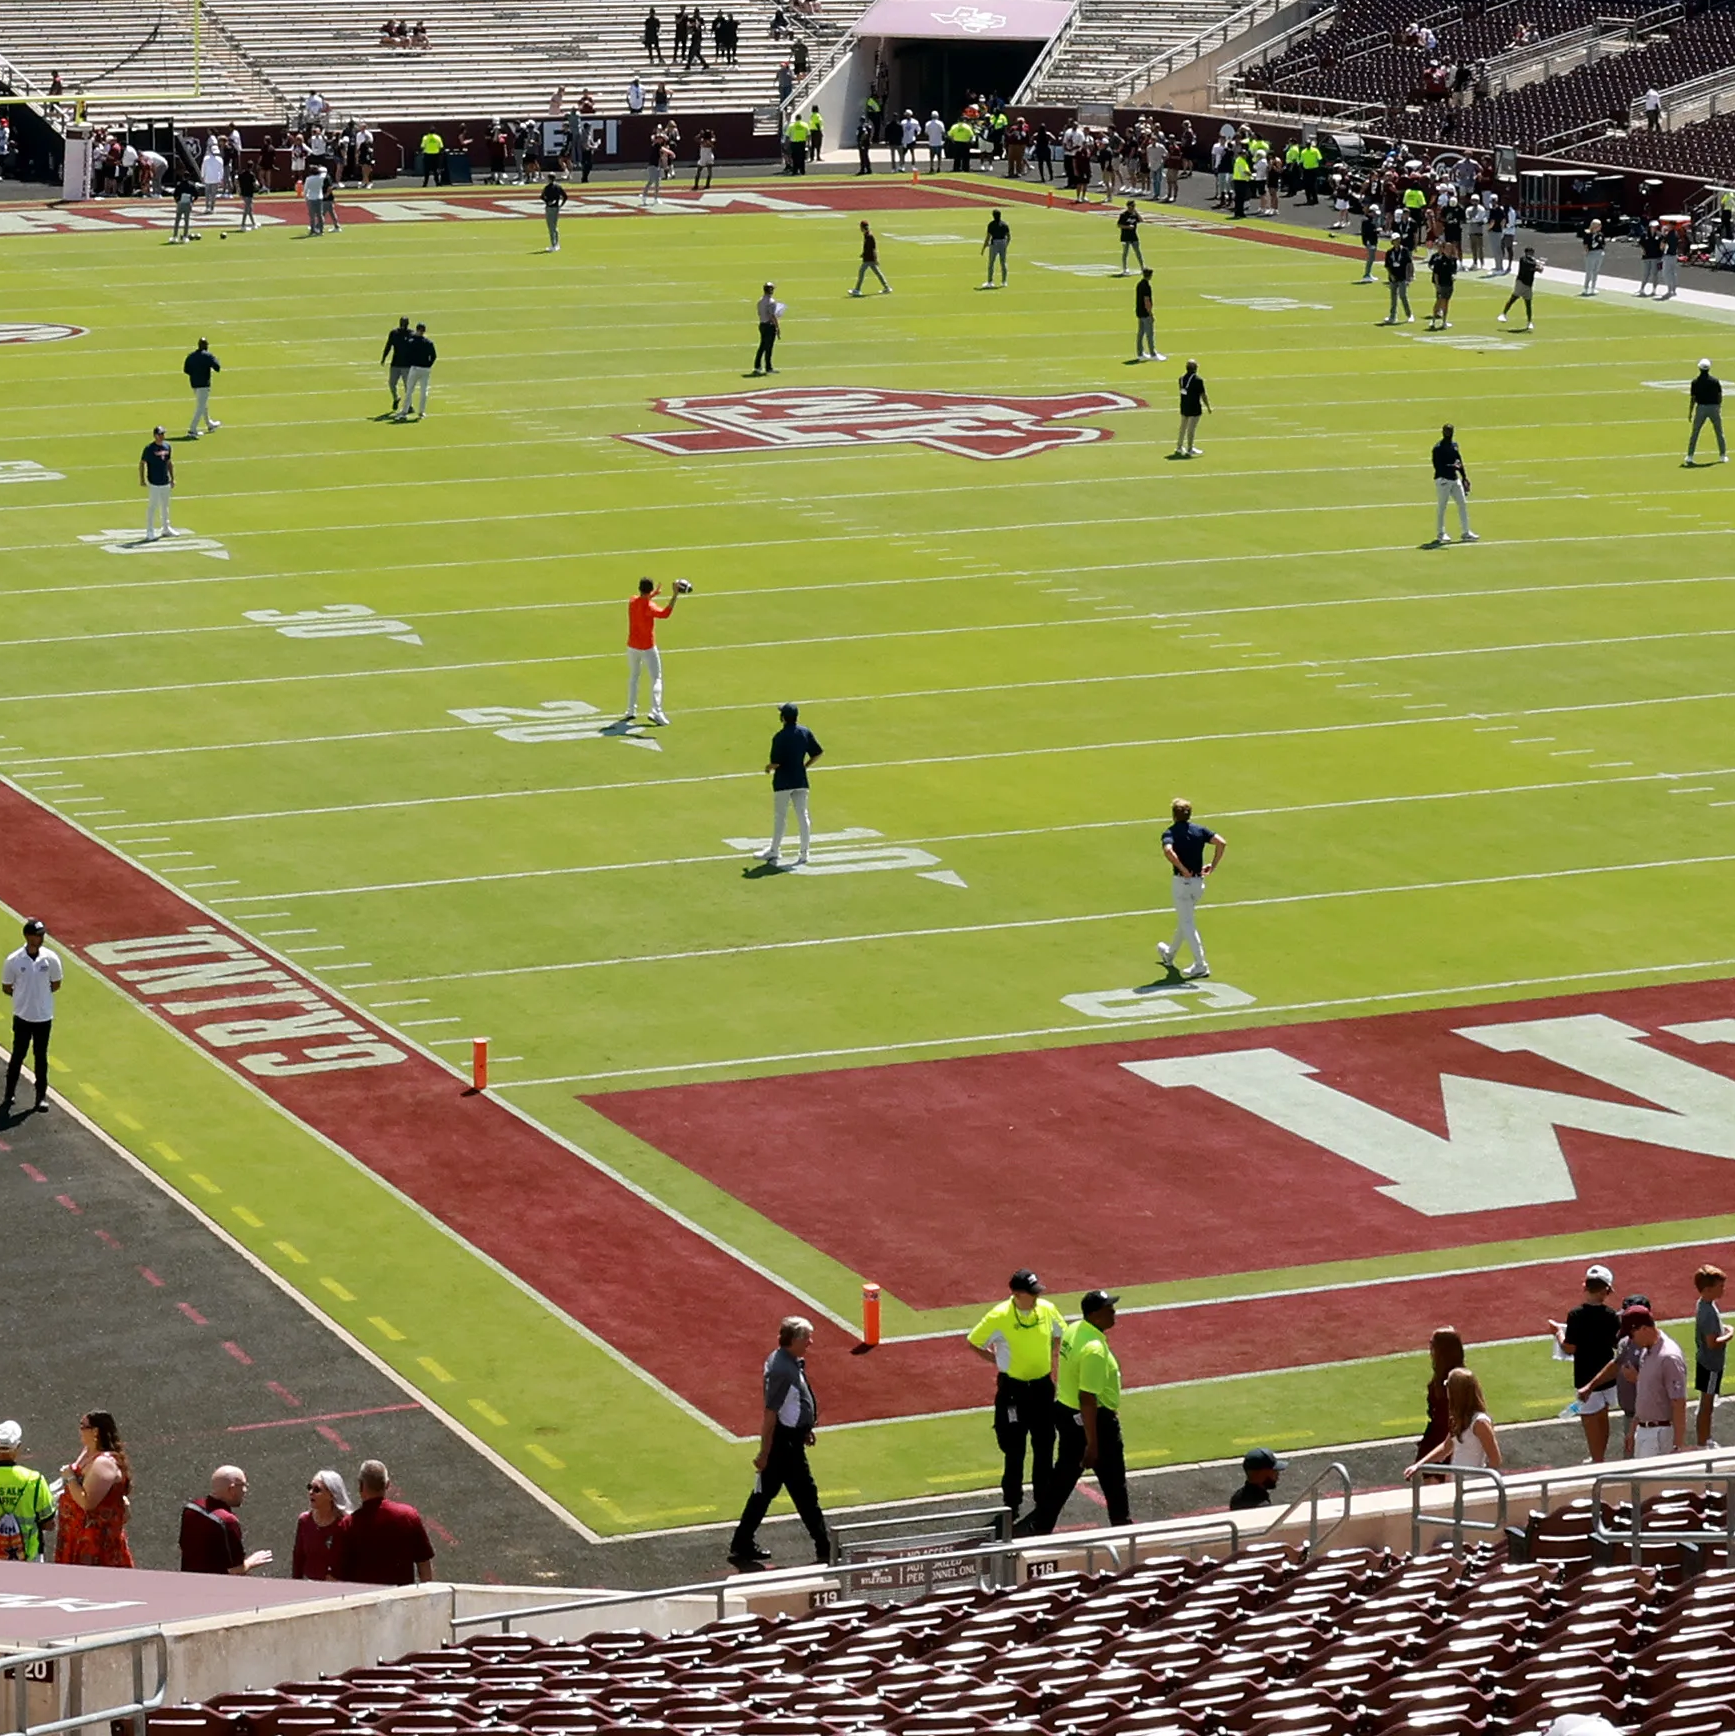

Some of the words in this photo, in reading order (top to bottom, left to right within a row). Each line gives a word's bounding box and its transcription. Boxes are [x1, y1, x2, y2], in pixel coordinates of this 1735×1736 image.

[357, 191, 832, 221] A&M
[241, 603, 414, 639] 30
[447, 699, 647, 744] 20
[722, 827, 942, 876] 10
